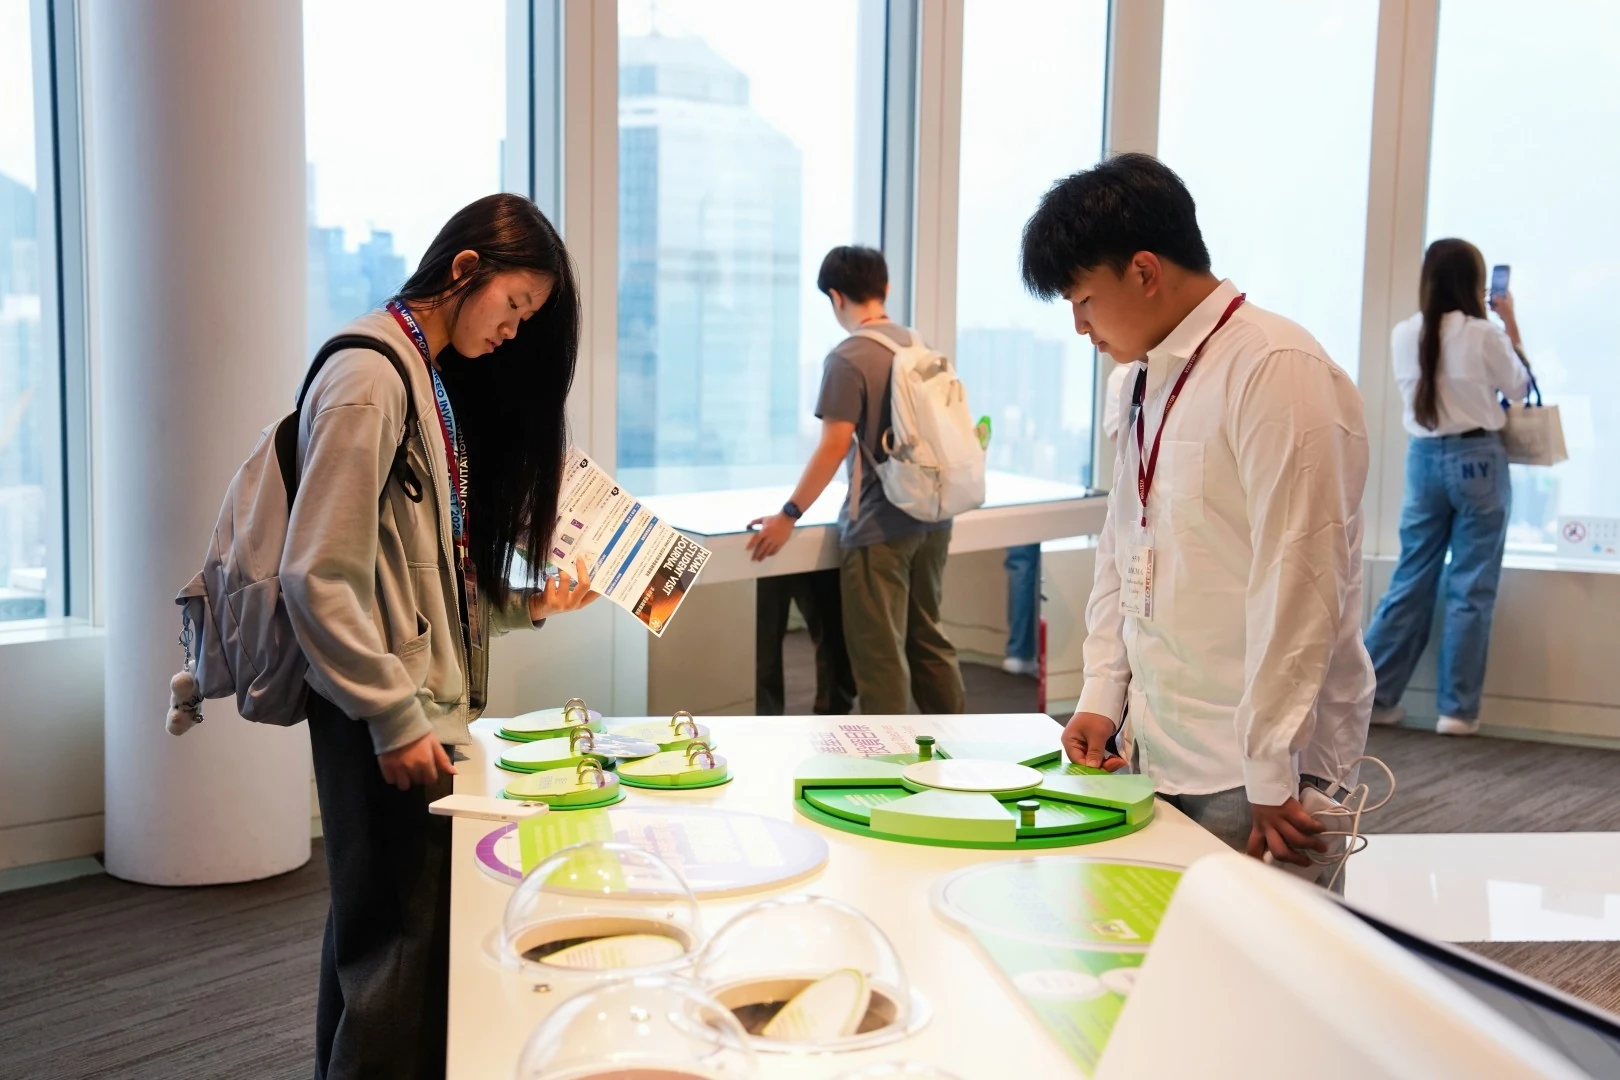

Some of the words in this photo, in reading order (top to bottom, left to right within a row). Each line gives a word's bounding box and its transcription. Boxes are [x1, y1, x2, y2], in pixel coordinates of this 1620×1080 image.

[1461, 461, 1490, 480] NY
[451, 508, 460, 536] 2026
[662, 536, 689, 571] JOURNAL
[673, 543, 698, 578] STUDENT
[687, 548, 709, 574] HKMA
[662, 575, 680, 596] VISIT
